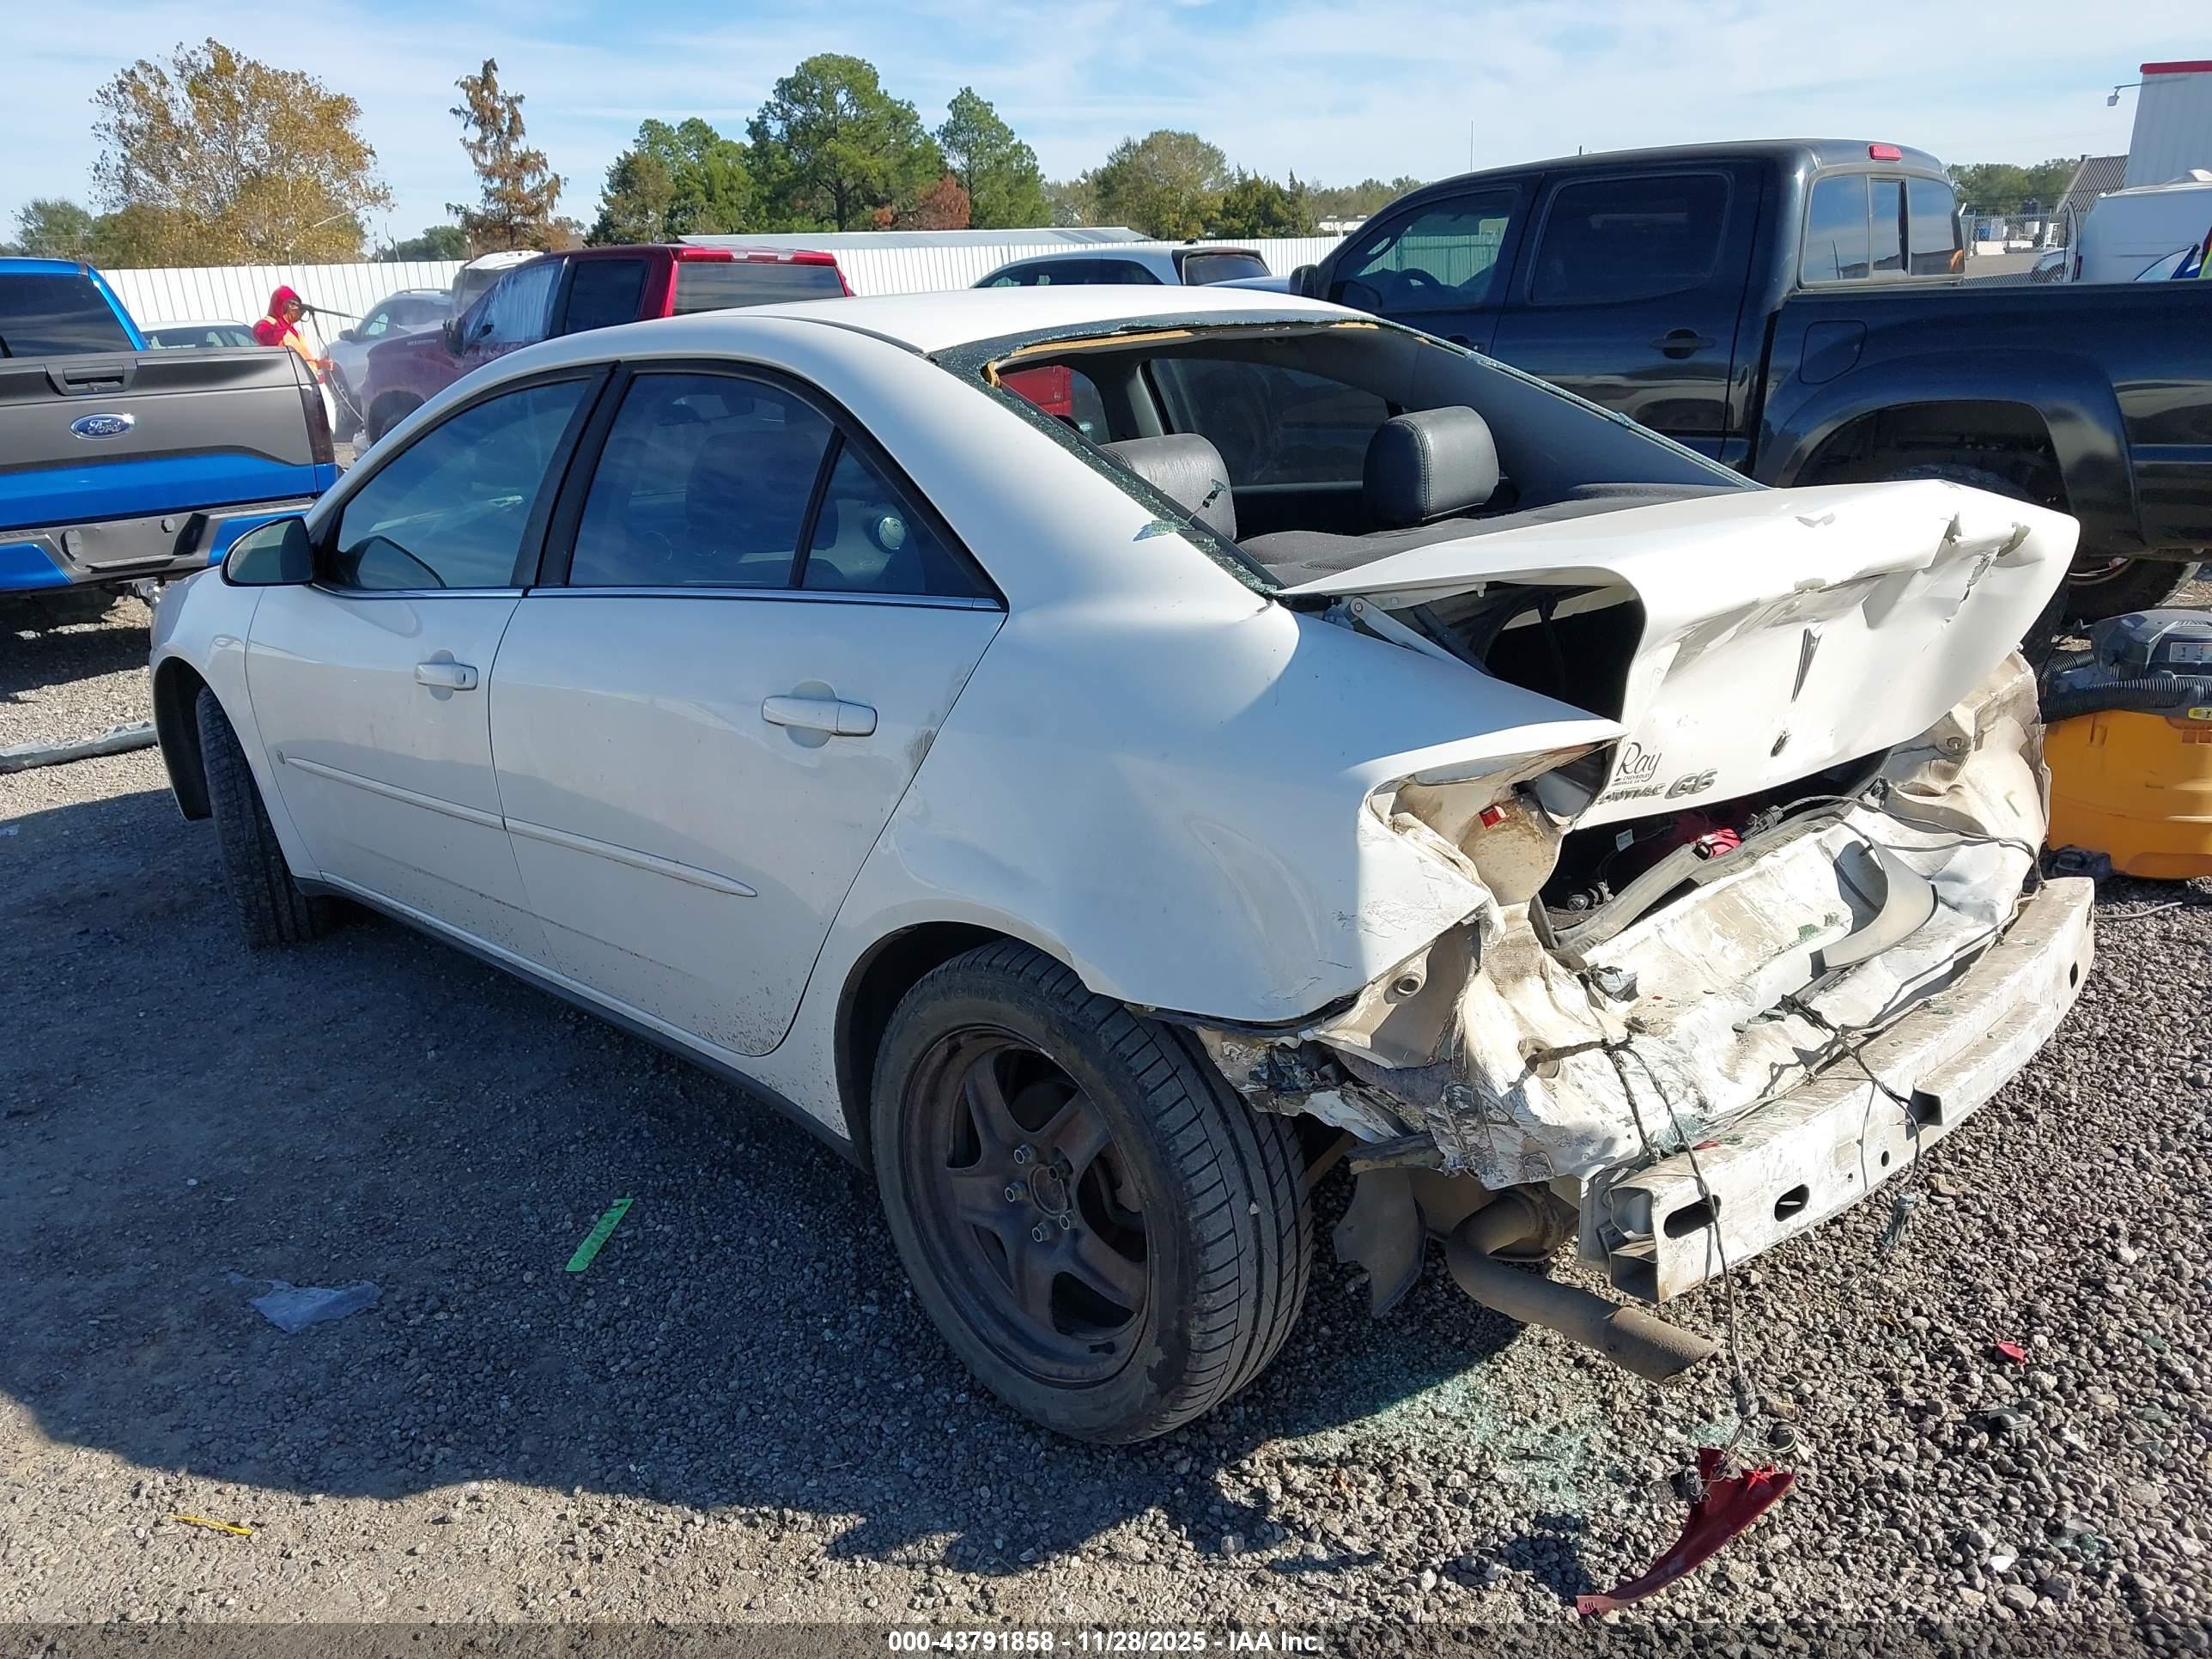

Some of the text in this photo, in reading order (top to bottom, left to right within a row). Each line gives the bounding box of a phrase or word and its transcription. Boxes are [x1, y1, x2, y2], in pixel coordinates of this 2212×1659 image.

[88, 418, 122, 434] Ford
[1616, 742, 1662, 782] Ray
[1664, 768, 1718, 799] G6
